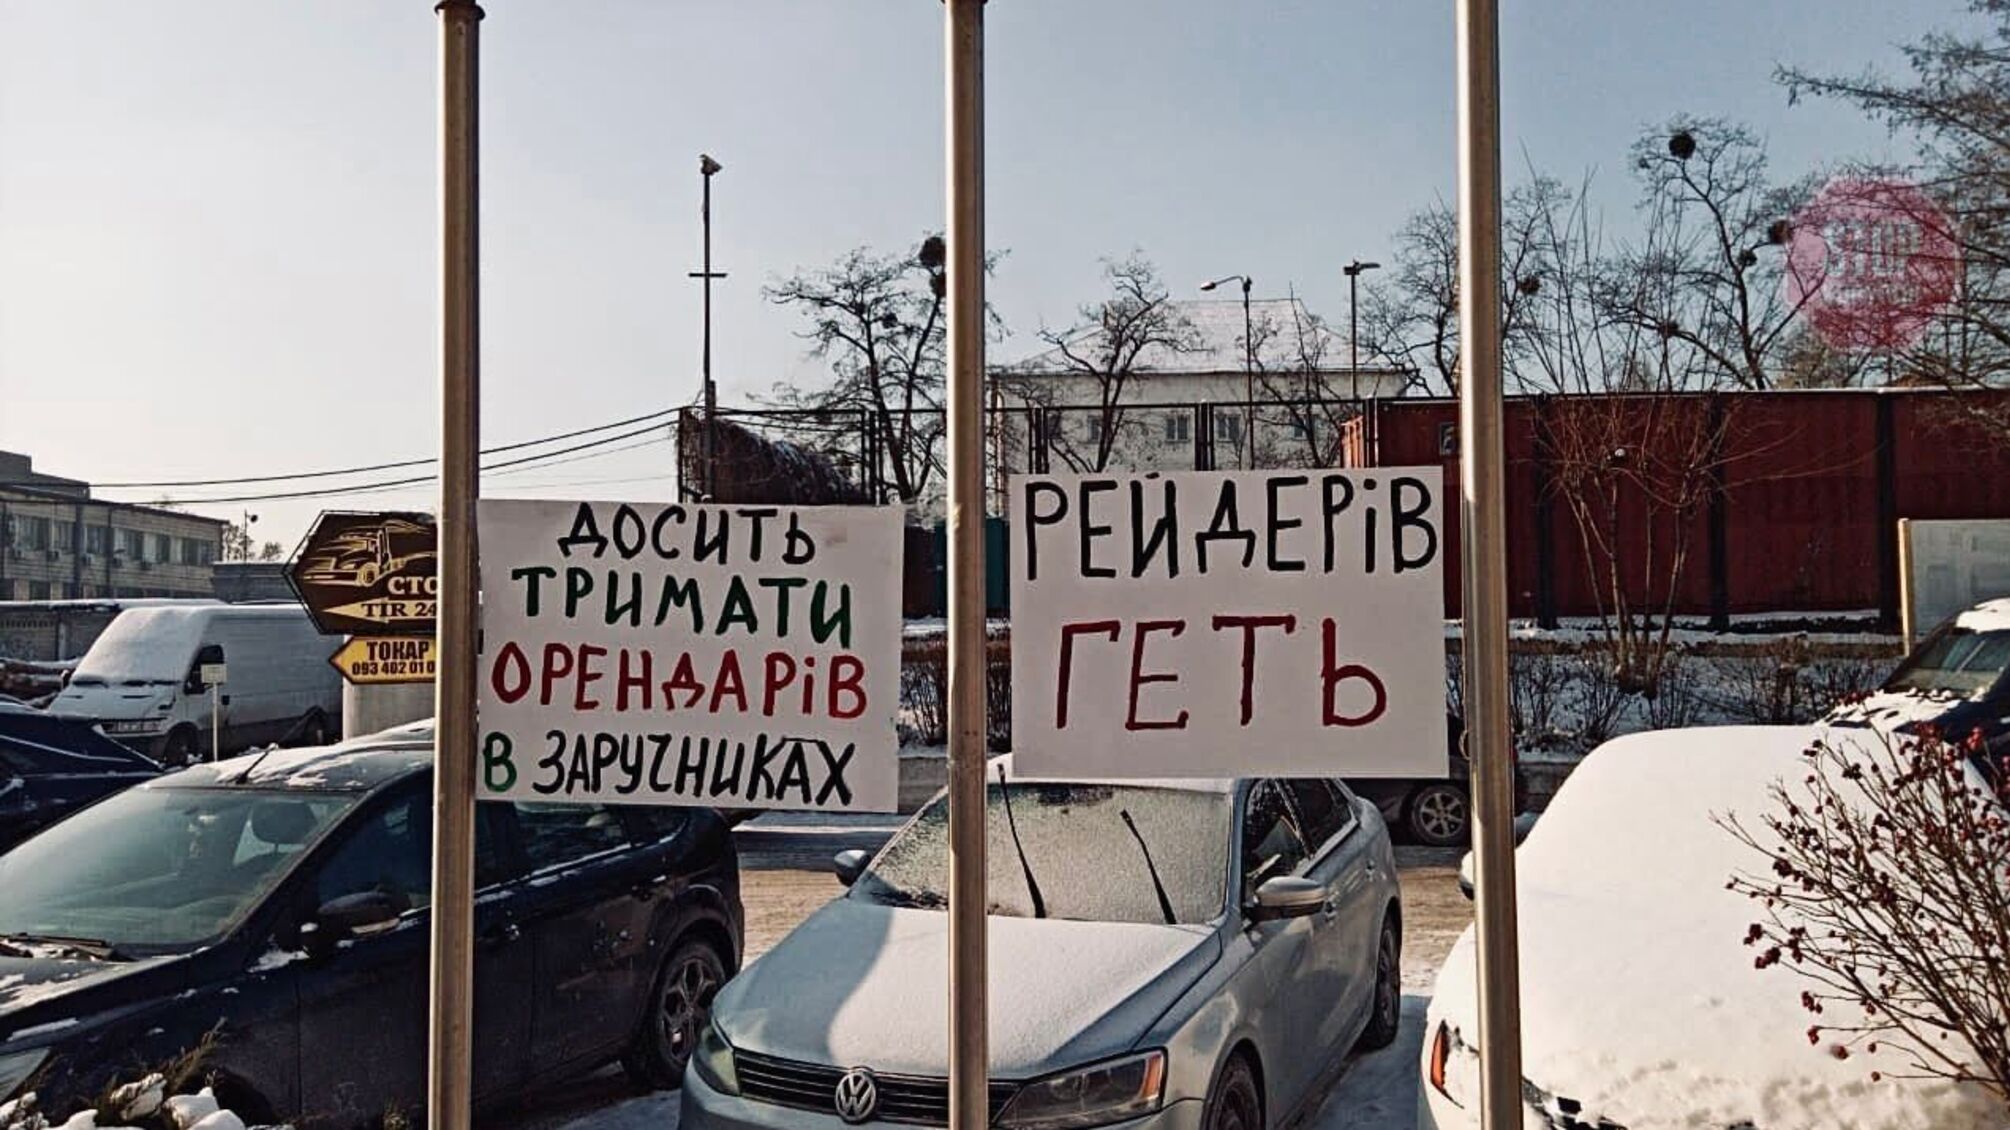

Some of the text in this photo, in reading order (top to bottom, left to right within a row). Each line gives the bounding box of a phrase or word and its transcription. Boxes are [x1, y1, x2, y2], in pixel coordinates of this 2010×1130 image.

[558, 502, 816, 565] ДОСИТЬ
[361, 603, 408, 617] TIR
[511, 566, 851, 649] ТРИМАТИ
[352, 662, 378, 675] 093
[381, 662, 406, 674] 402
[366, 641, 429, 660] ТОКАР
[1057, 615, 1387, 730] ГЕТЬ
[482, 730, 855, 805] В ЗАРУЧНИКАХ
